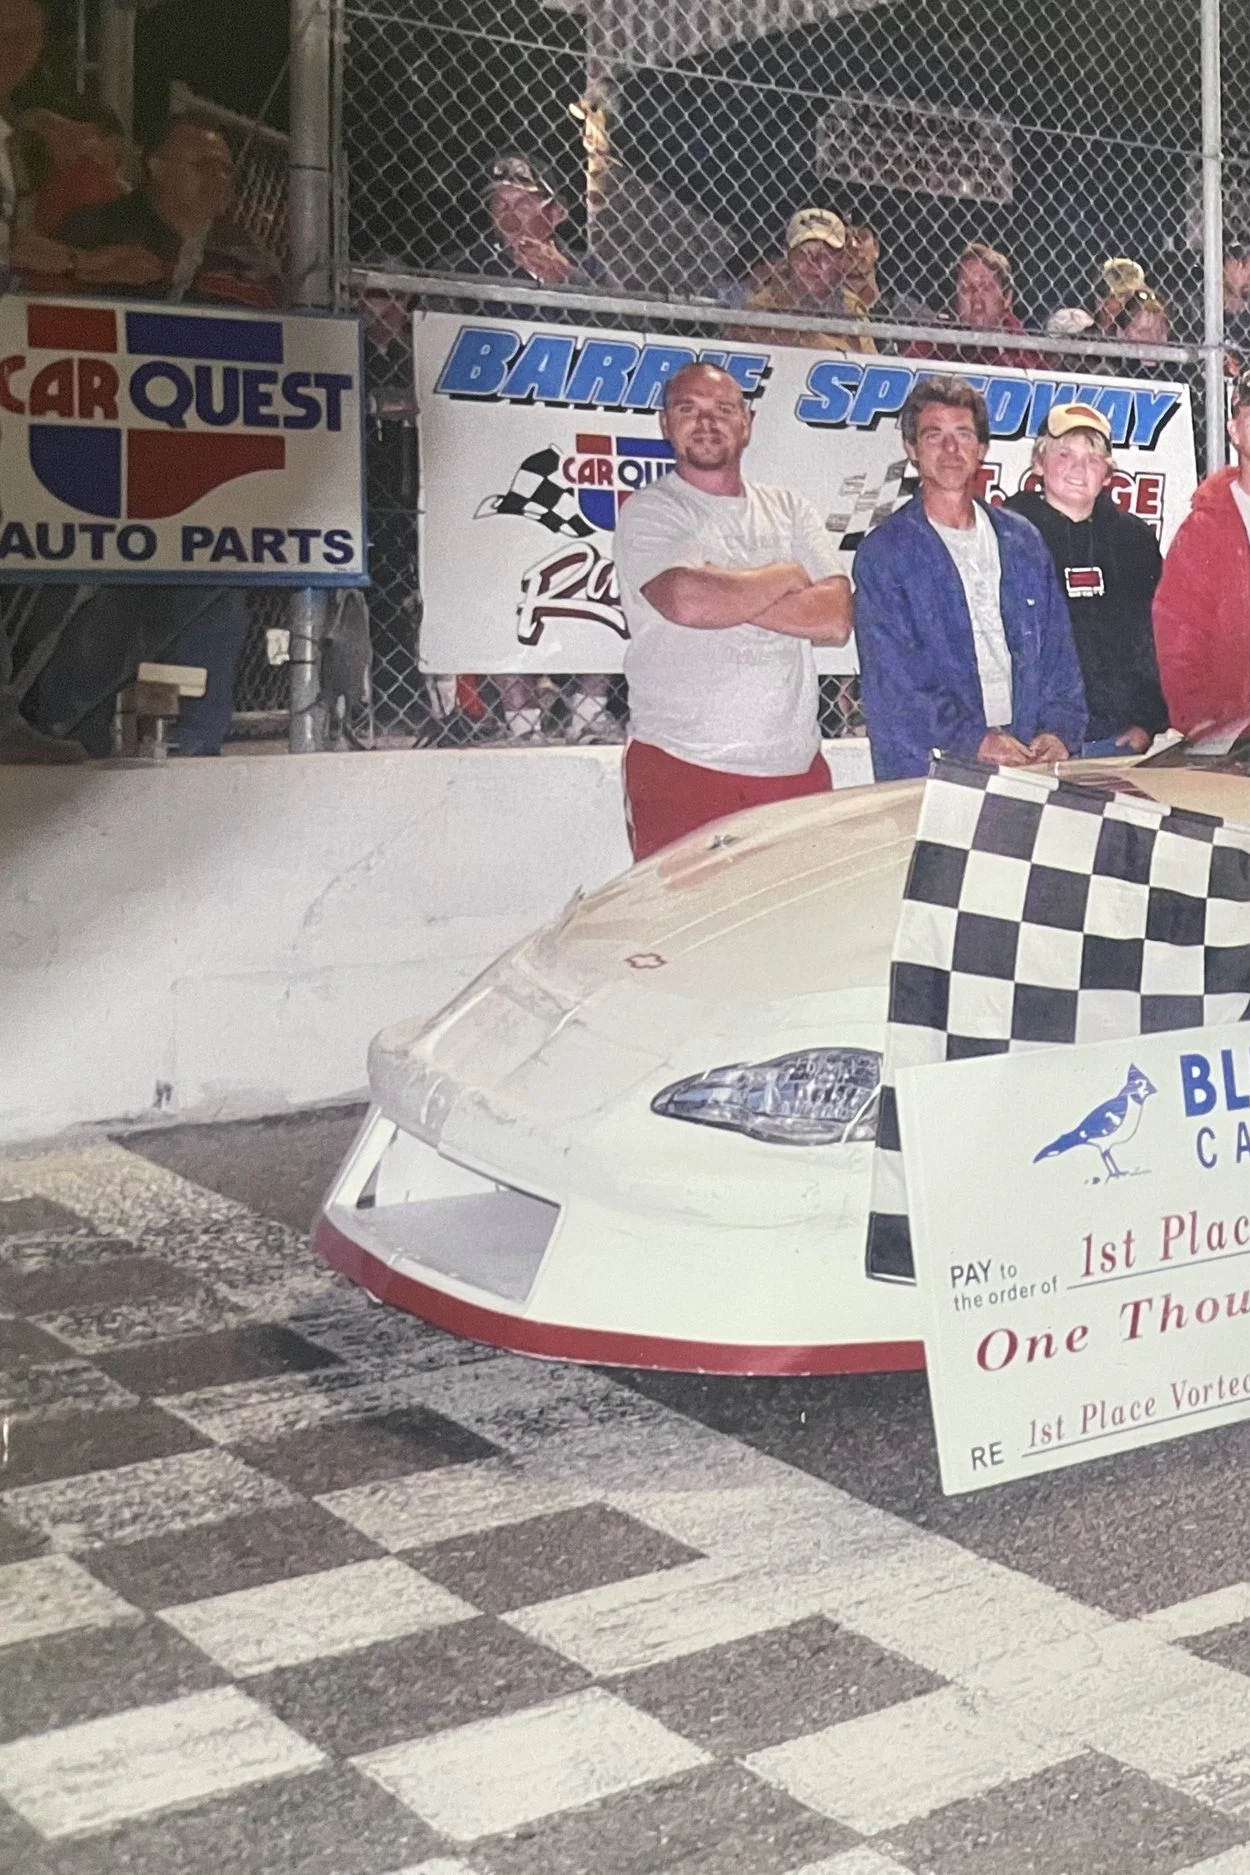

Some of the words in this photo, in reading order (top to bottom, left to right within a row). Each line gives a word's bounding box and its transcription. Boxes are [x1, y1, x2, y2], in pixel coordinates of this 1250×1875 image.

[0, 522, 157, 562] AUTO
[181, 526, 355, 565] PARTS
[951, 1259, 992, 1288] PAY
[1000, 1263, 1017, 1280] to
[1081, 1229, 1136, 1277] 1st
[954, 1294, 983, 1311] the
[988, 1281, 1035, 1305] order
[1041, 1275, 1058, 1294] of
[976, 1323, 1089, 1372] One
[971, 1442, 1004, 1471] RE
[1028, 1419, 1065, 1448] 1st
[1080, 1397, 1156, 1435] Place
